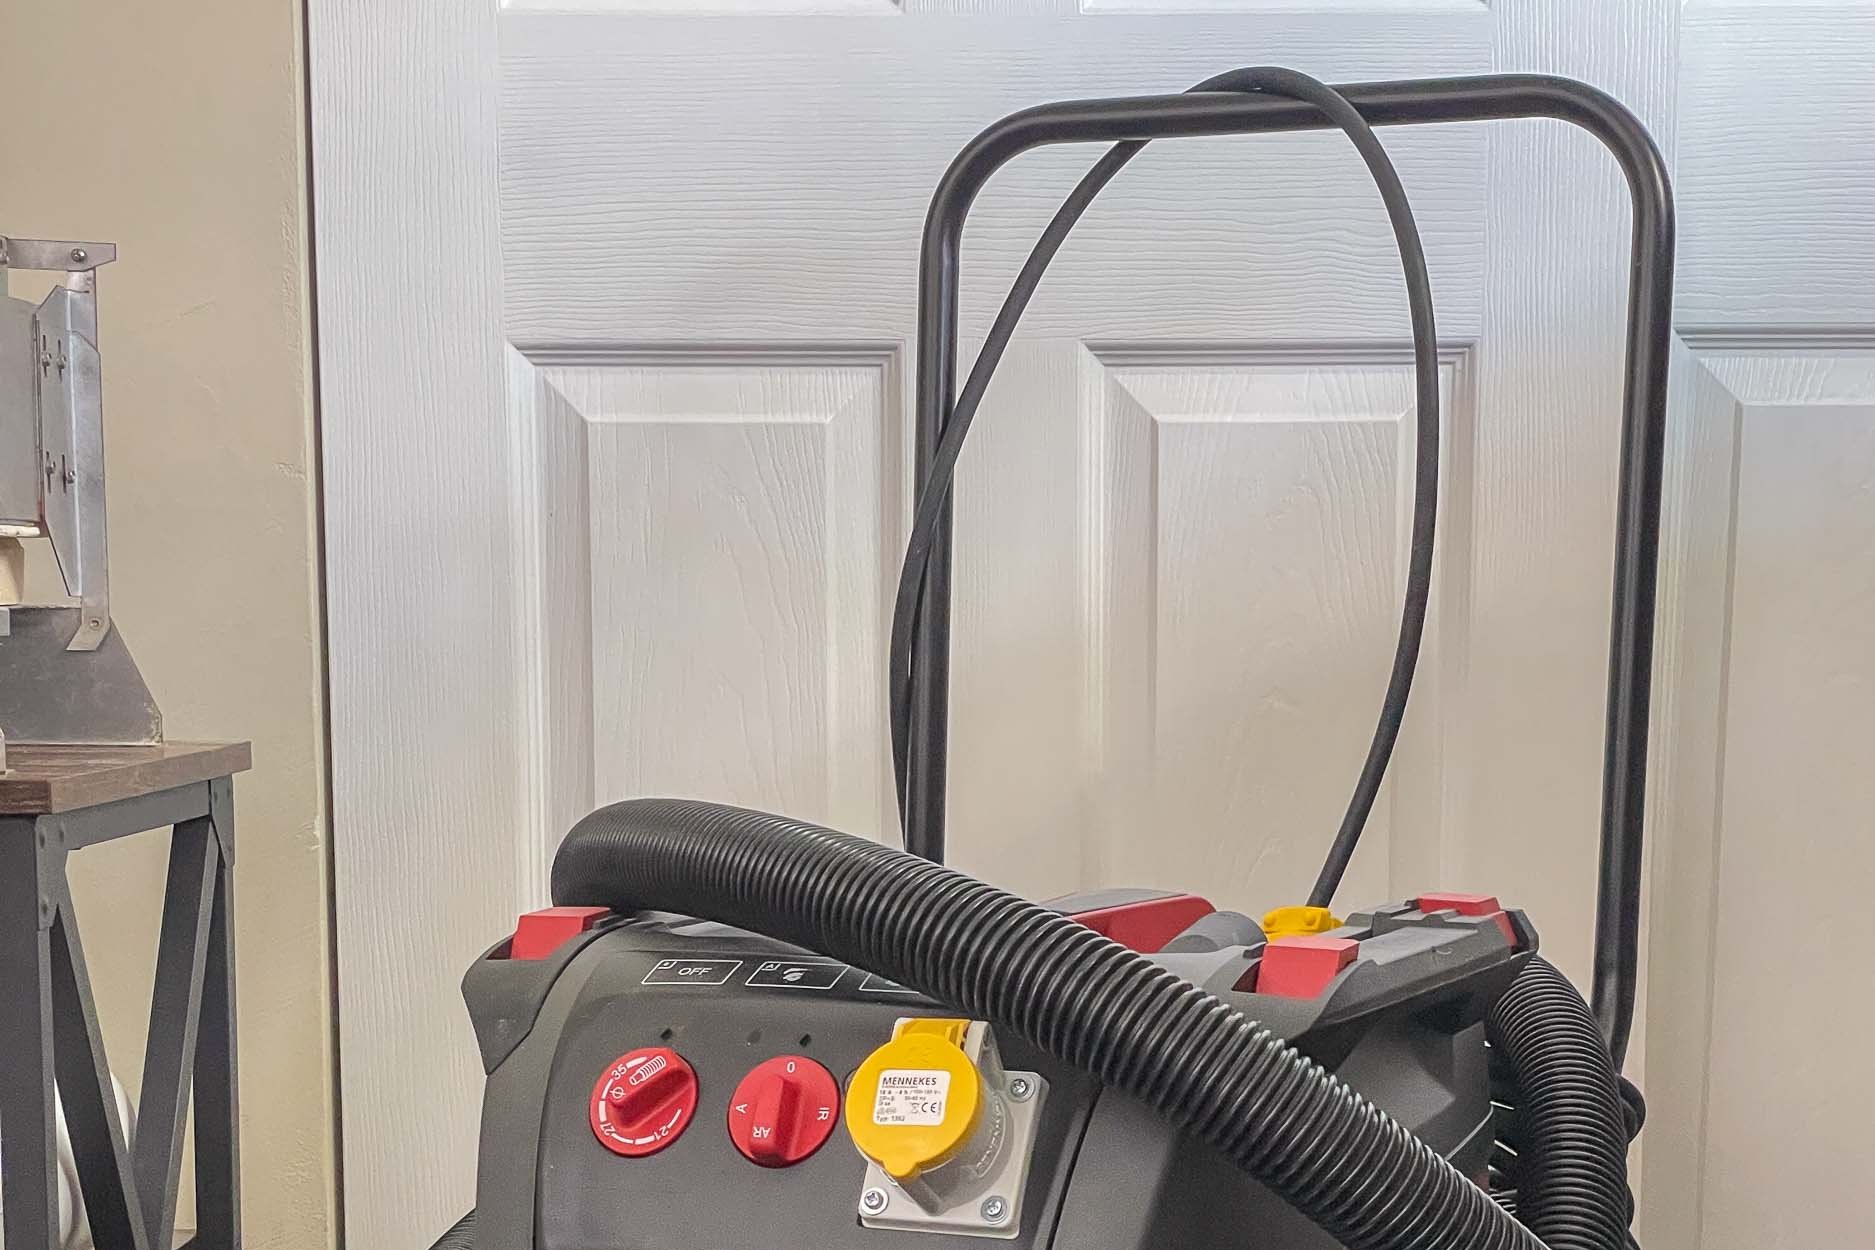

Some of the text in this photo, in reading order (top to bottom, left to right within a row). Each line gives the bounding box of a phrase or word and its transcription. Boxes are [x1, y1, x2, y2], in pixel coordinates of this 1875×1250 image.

[678, 967, 713, 976] OFF
[612, 1063, 628, 1080] 35
[882, 1077, 937, 1086] MENNEKES
[735, 1103, 748, 1114] A
[816, 1106, 830, 1121] IR
[654, 1127, 669, 1141] 21
[753, 1126, 772, 1139] AR
